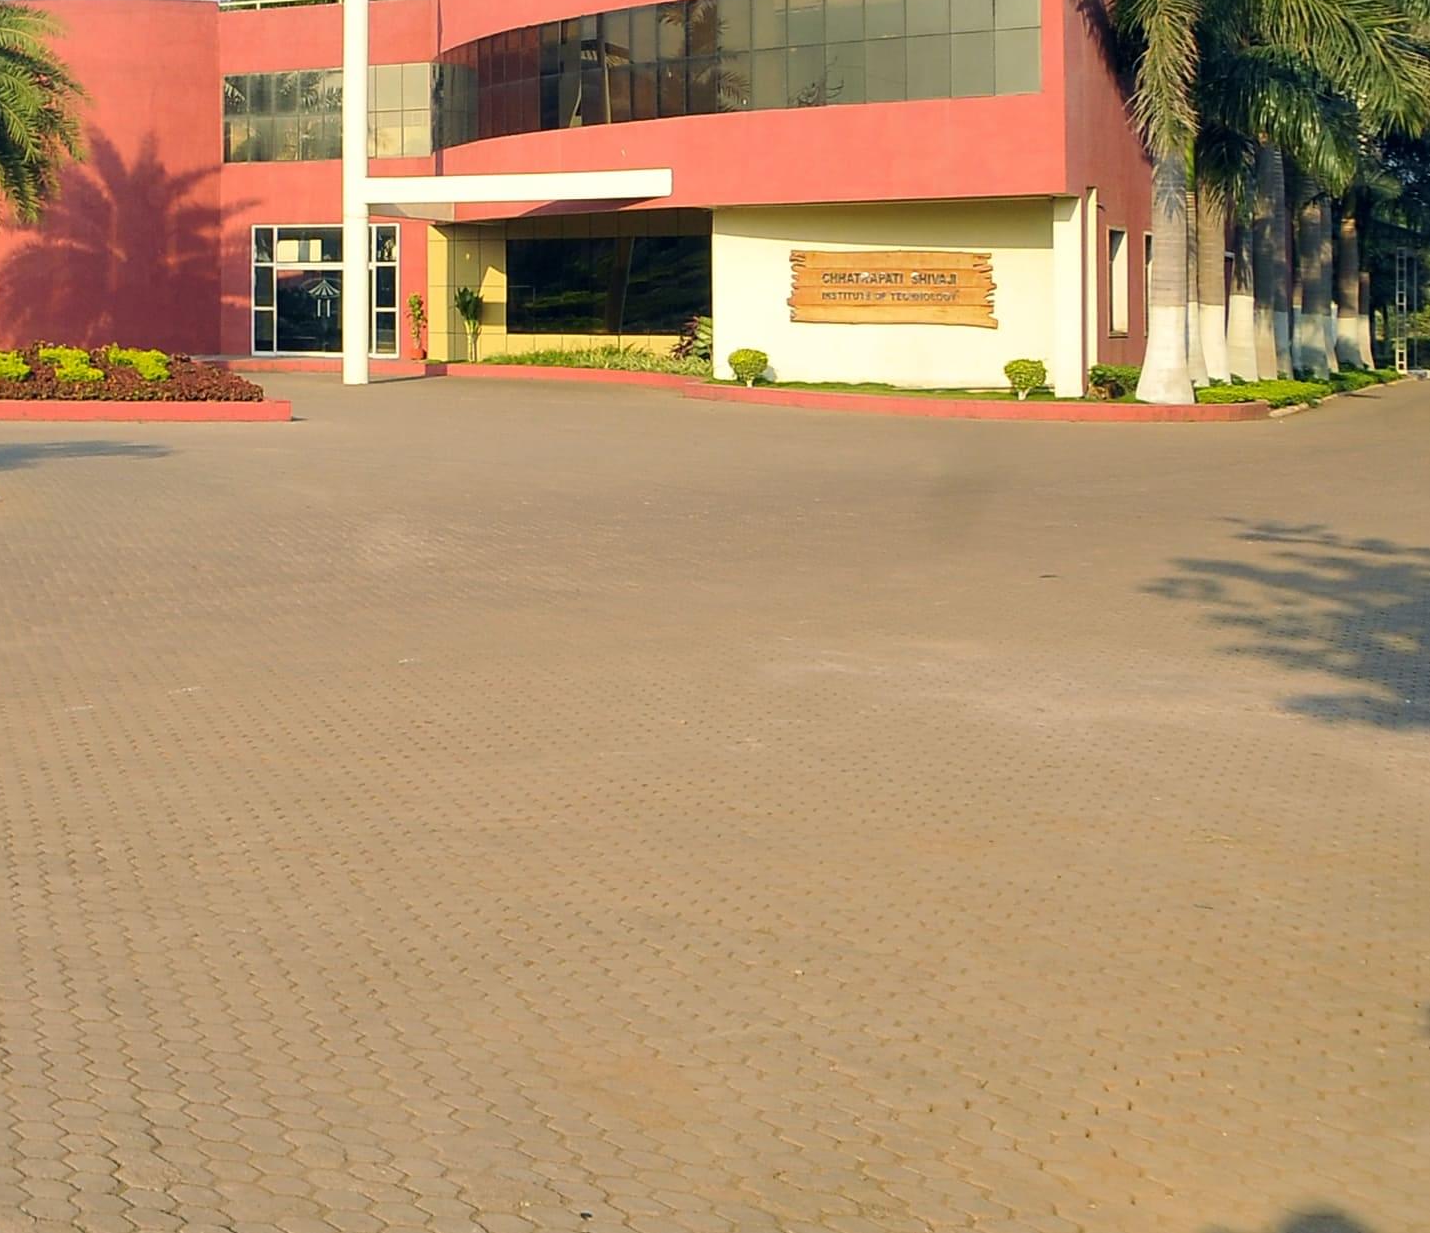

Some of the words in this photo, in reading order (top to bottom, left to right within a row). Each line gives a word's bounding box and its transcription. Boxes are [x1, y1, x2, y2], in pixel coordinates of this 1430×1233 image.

[822, 272, 904, 284] CHHATRAPATI
[911, 272, 957, 285] SHIVAJI
[822, 291, 871, 301] INSTITUTE
[875, 291, 886, 301] OF
[891, 292, 957, 302] TECHNOLOGY
